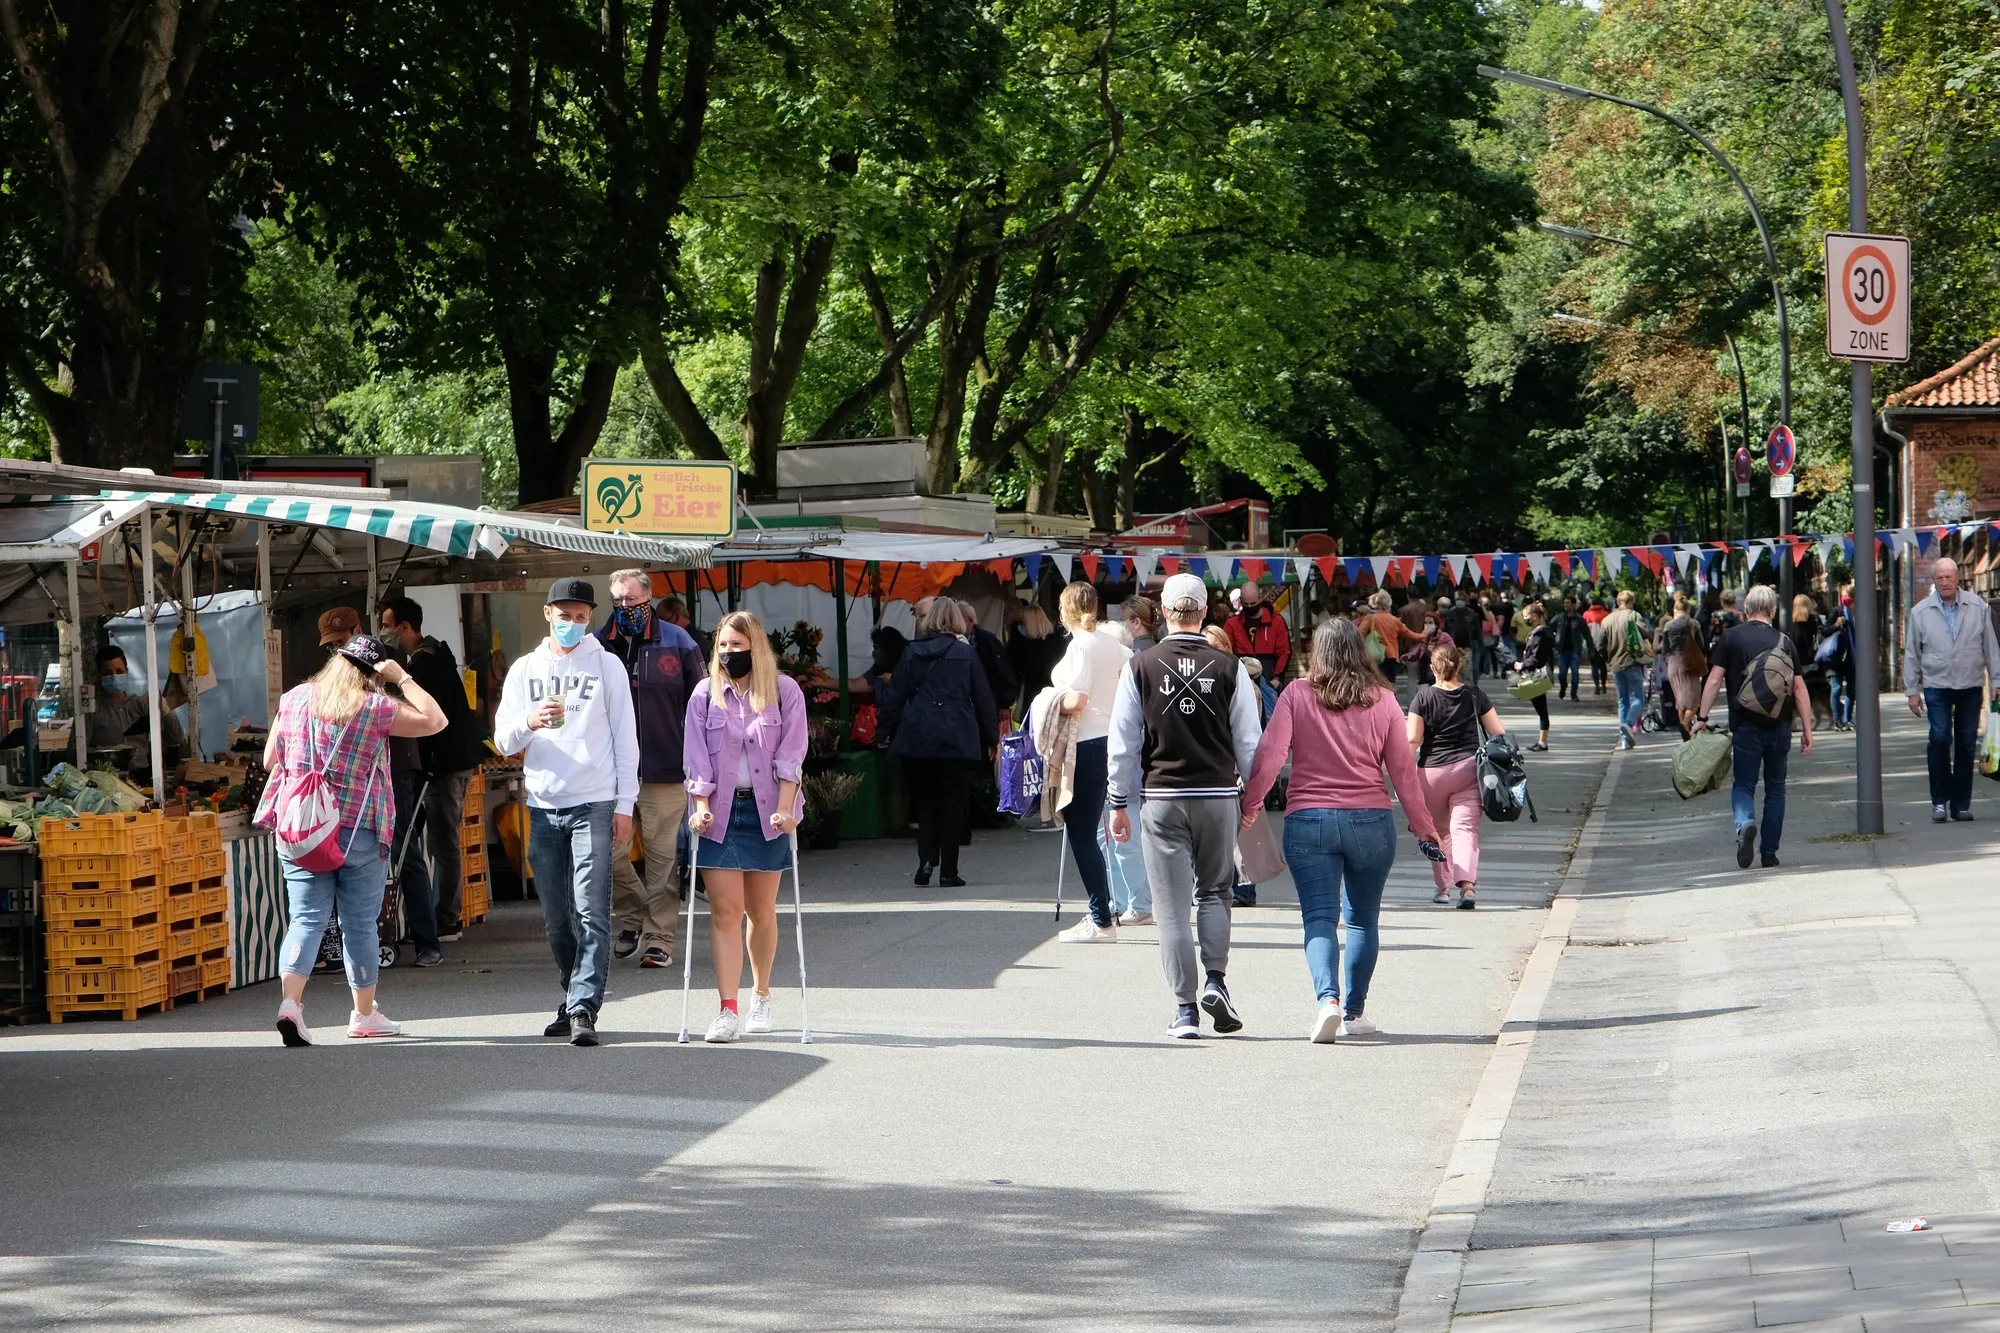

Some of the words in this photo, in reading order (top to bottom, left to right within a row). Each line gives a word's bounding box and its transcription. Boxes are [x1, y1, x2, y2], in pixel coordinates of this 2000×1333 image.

[1854, 267, 1884, 303] 30
[1850, 330, 1888, 351] ZONE
[653, 472, 700, 483] täglich
[676, 483, 723, 493] frische
[652, 493, 722, 518] Eier
[356, 636, 377, 651] CUTE
[1178, 658, 1196, 677] HH
[529, 675, 599, 702] DOPE
